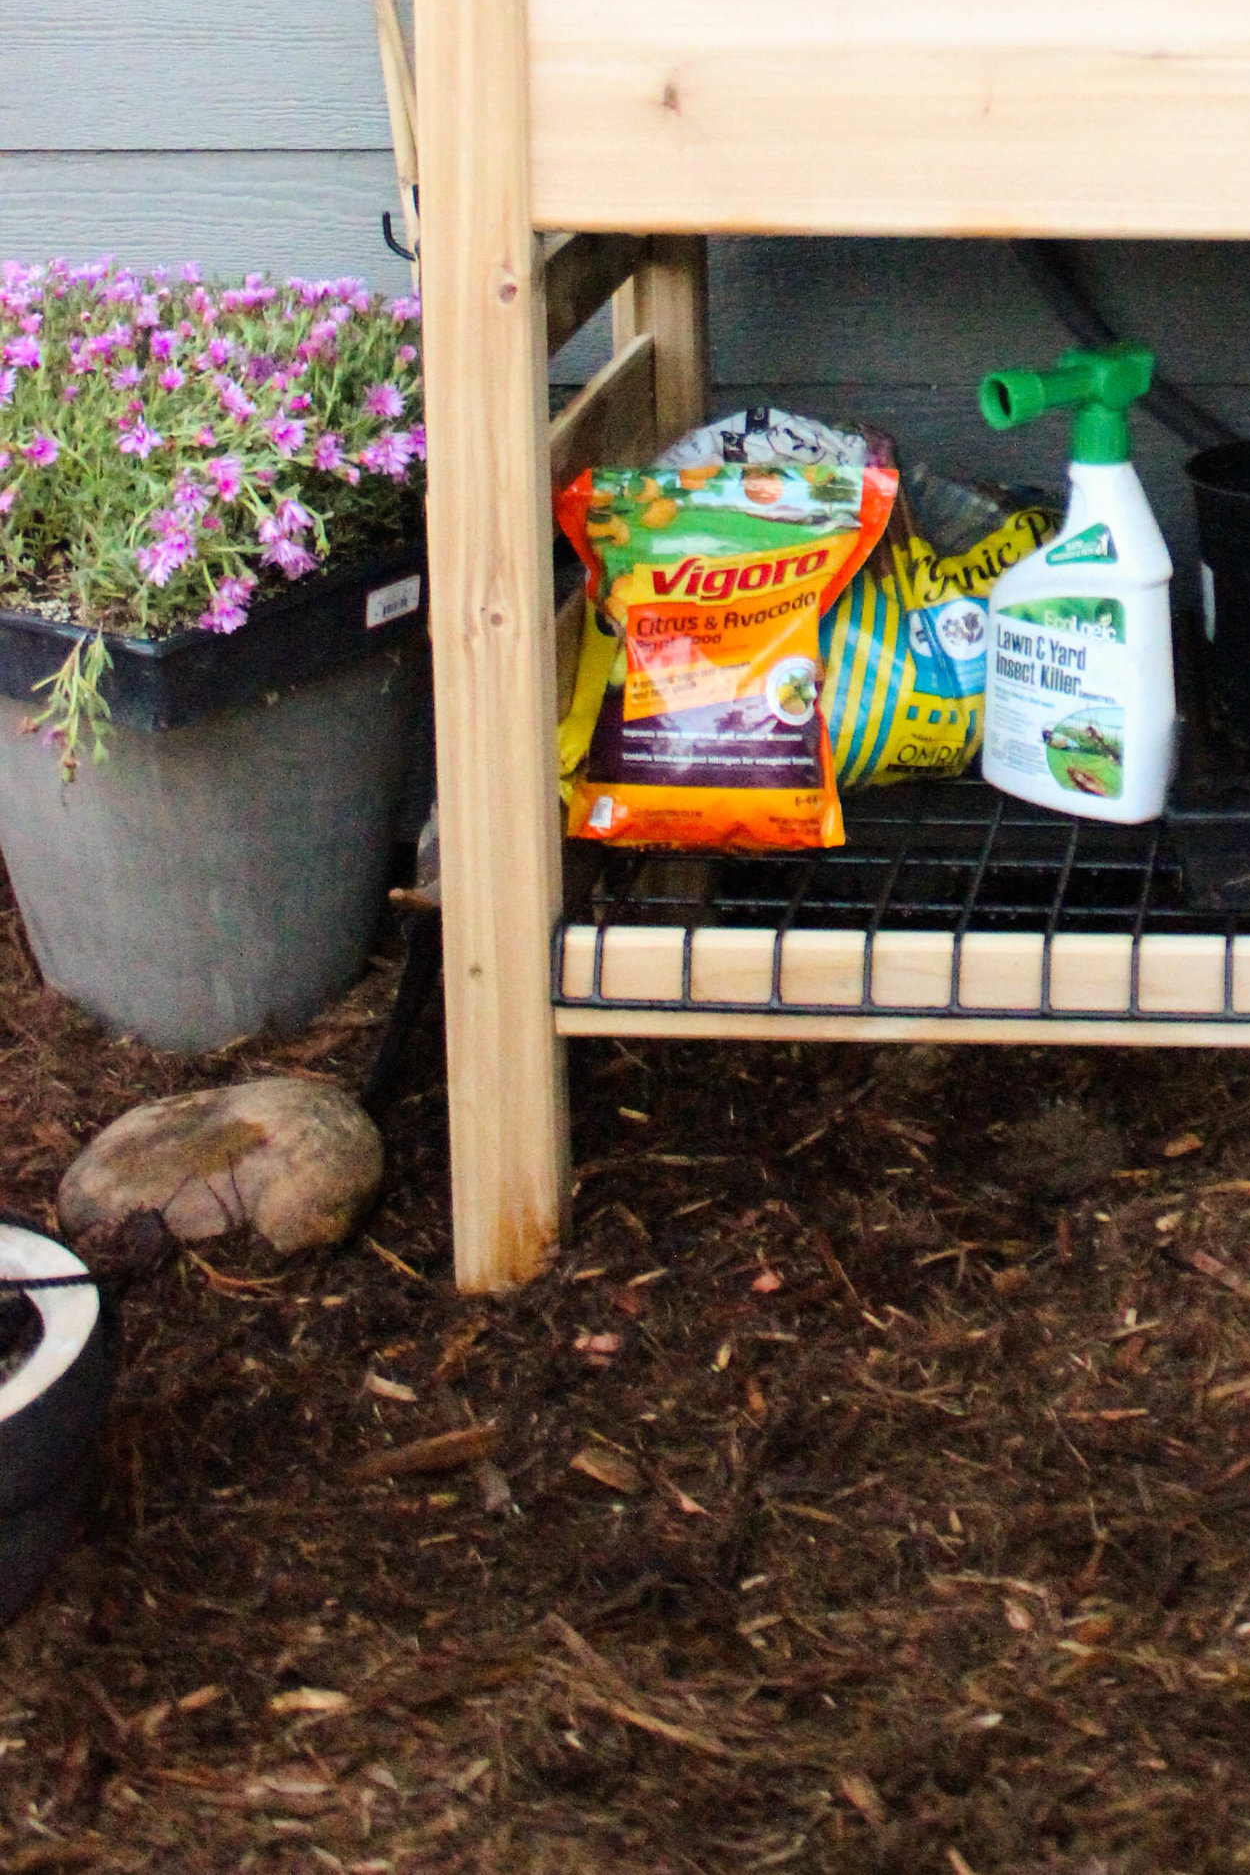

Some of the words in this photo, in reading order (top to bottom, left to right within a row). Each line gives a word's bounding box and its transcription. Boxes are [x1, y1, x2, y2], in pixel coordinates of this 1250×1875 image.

[651, 549, 829, 601] Vigoro
[636, 615, 699, 638] Citrus
[704, 614, 718, 631] &
[723, 591, 816, 630] Avocado
[996, 623, 1033, 657] Lawn
[1049, 638, 1087, 671] Yard
[996, 649, 1036, 686] Insect
[1040, 664, 1082, 696] Killer
